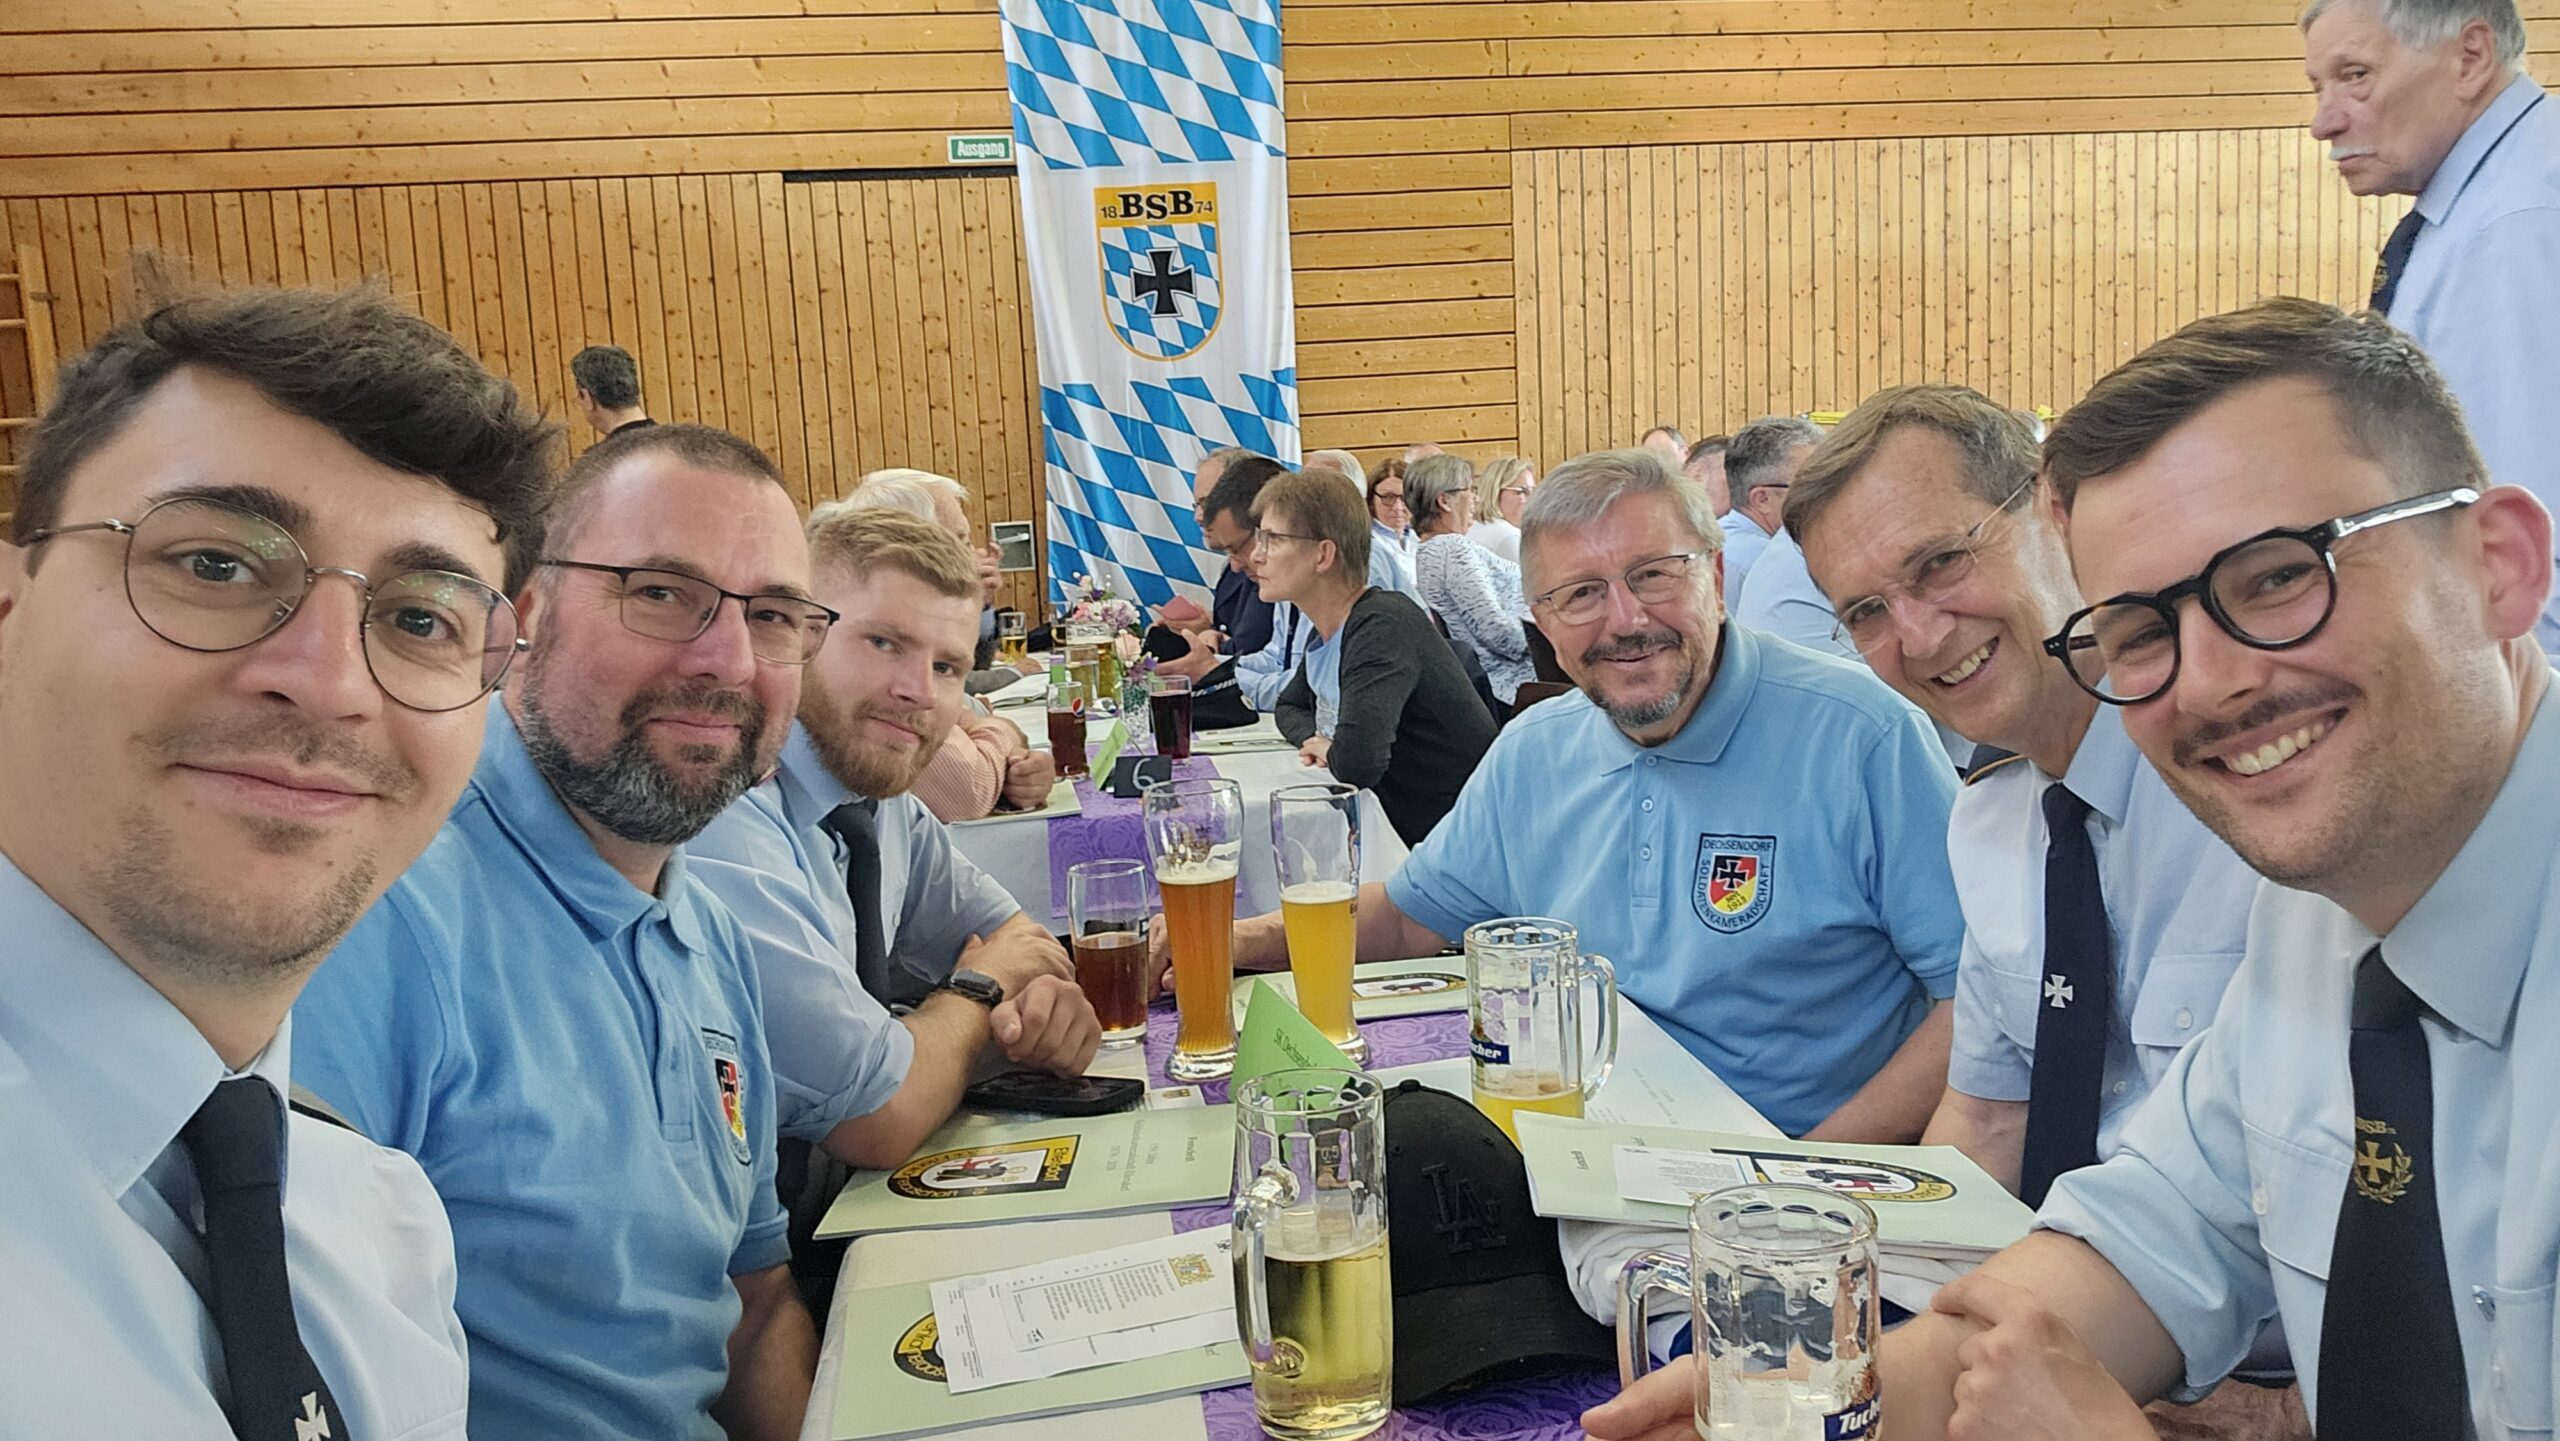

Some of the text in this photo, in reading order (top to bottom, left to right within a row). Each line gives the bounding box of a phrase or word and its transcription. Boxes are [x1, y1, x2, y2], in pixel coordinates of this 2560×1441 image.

[957, 140, 1005, 158] Ausgang
[1100, 190, 1213, 220] 18 BSB 74
